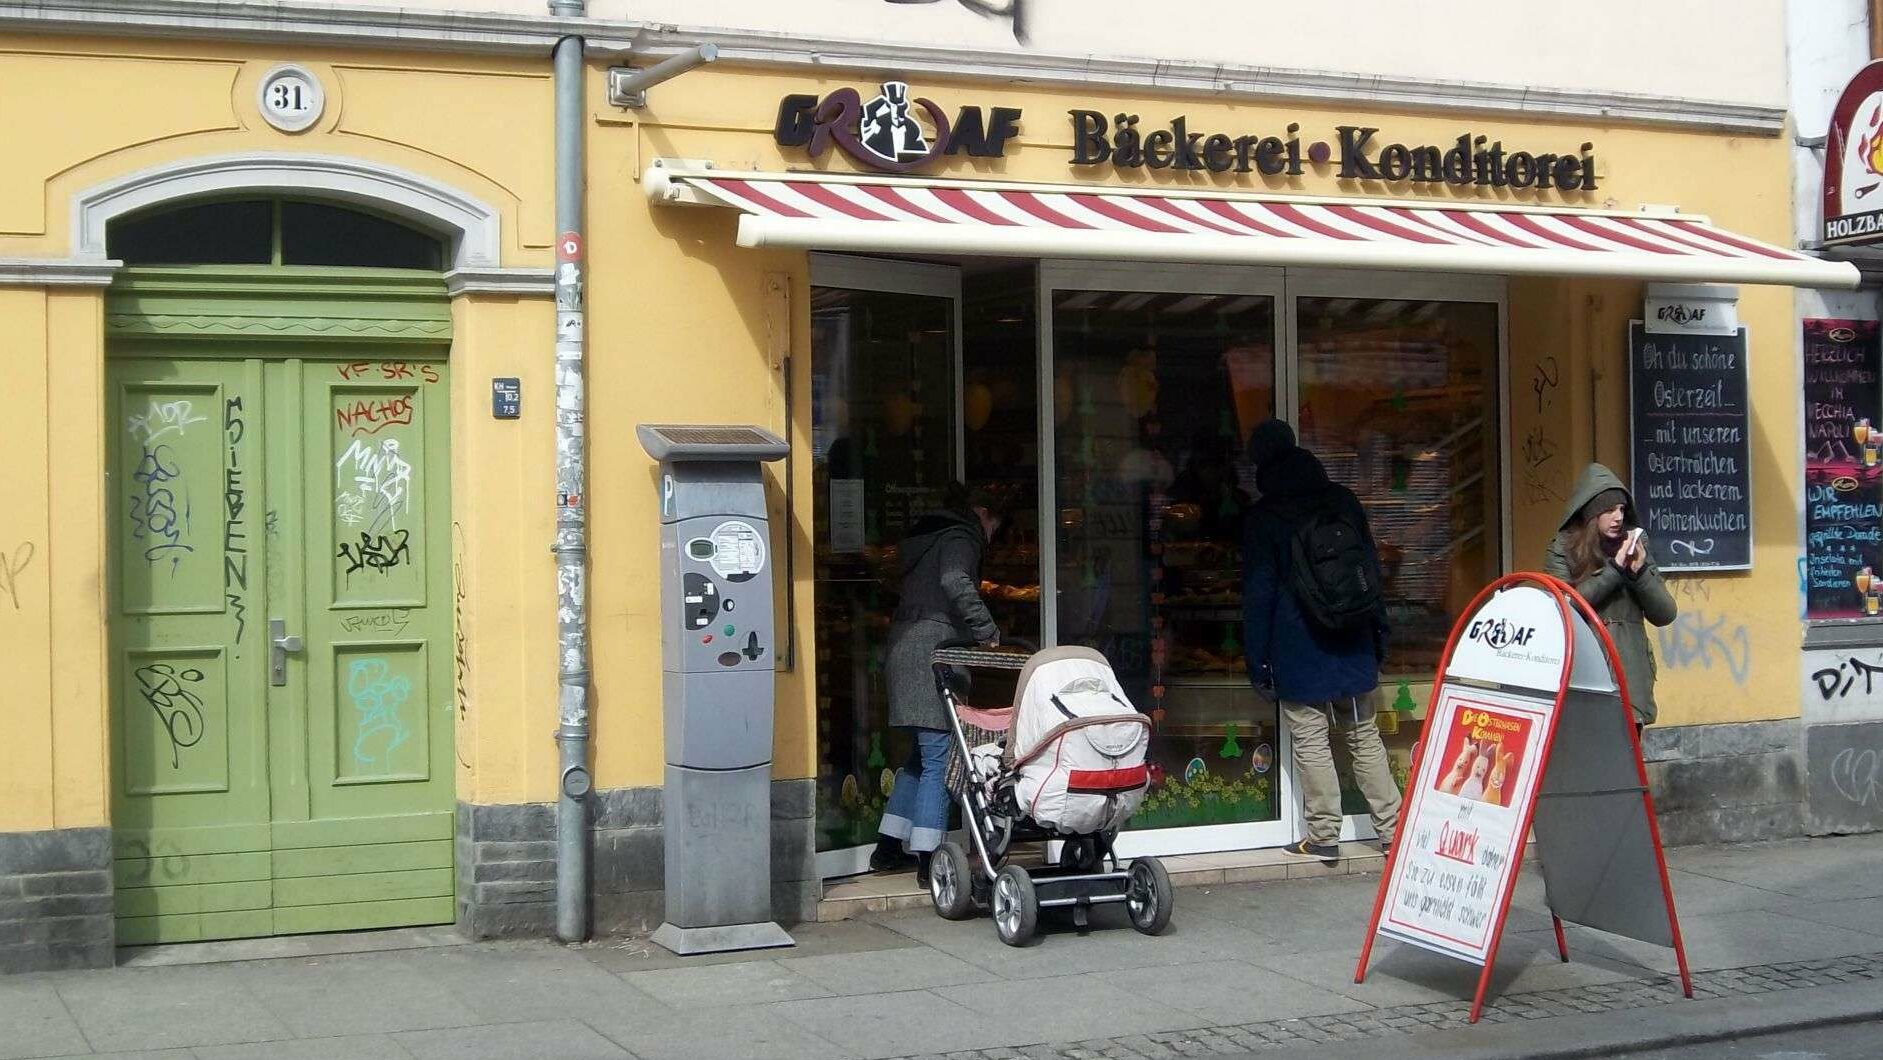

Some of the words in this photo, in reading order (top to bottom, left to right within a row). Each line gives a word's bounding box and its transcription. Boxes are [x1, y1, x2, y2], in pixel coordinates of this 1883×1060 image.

[1068, 109, 1305, 175] Bäckerei
[1335, 125, 1599, 191] Konditorei
[1668, 344, 1687, 369] du
[1692, 345, 1735, 369] schöne
[1654, 379, 1722, 408] Osterzeit
[336, 394, 414, 433] NACHOS
[1683, 426, 1741, 444] unseren
[1650, 480, 1673, 499] und
[1679, 478, 1743, 500] leckerem
[1808, 486, 1838, 502] WIR
[1649, 505, 1746, 532] Möhrenkuchen
[1813, 503, 1882, 520] EMPFEHLEN
[1439, 820, 1480, 861] Quark
